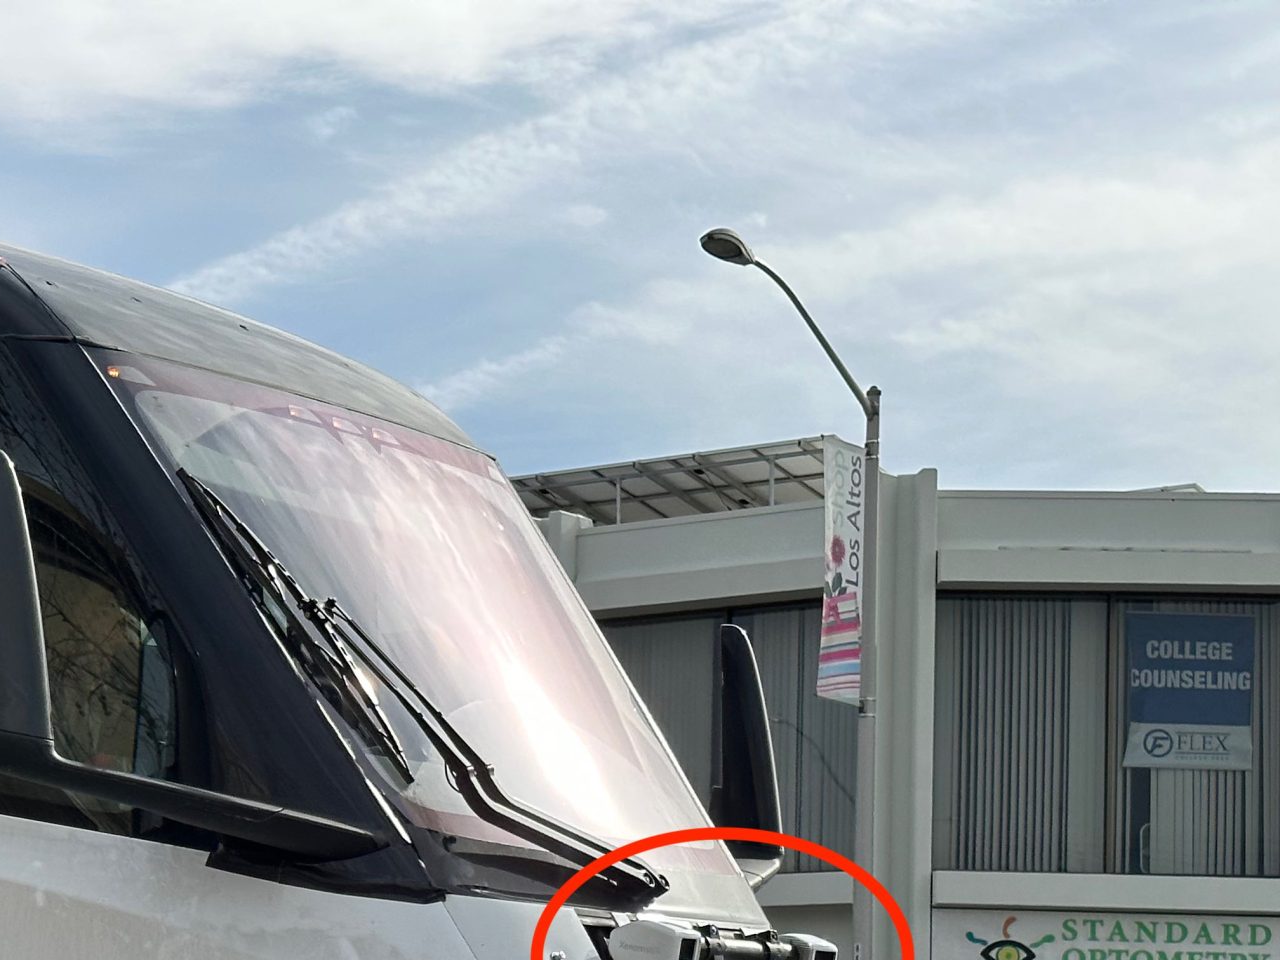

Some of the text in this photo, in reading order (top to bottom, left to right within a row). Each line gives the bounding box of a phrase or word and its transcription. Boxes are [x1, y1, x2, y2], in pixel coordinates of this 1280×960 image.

[845, 454, 863, 588] Los Altos
[1145, 639, 1234, 662] COLLEGE
[1131, 668, 1251, 691] COUNSELING
[1177, 735, 1229, 752] FLEX
[1061, 918, 1272, 946] STANDARD
